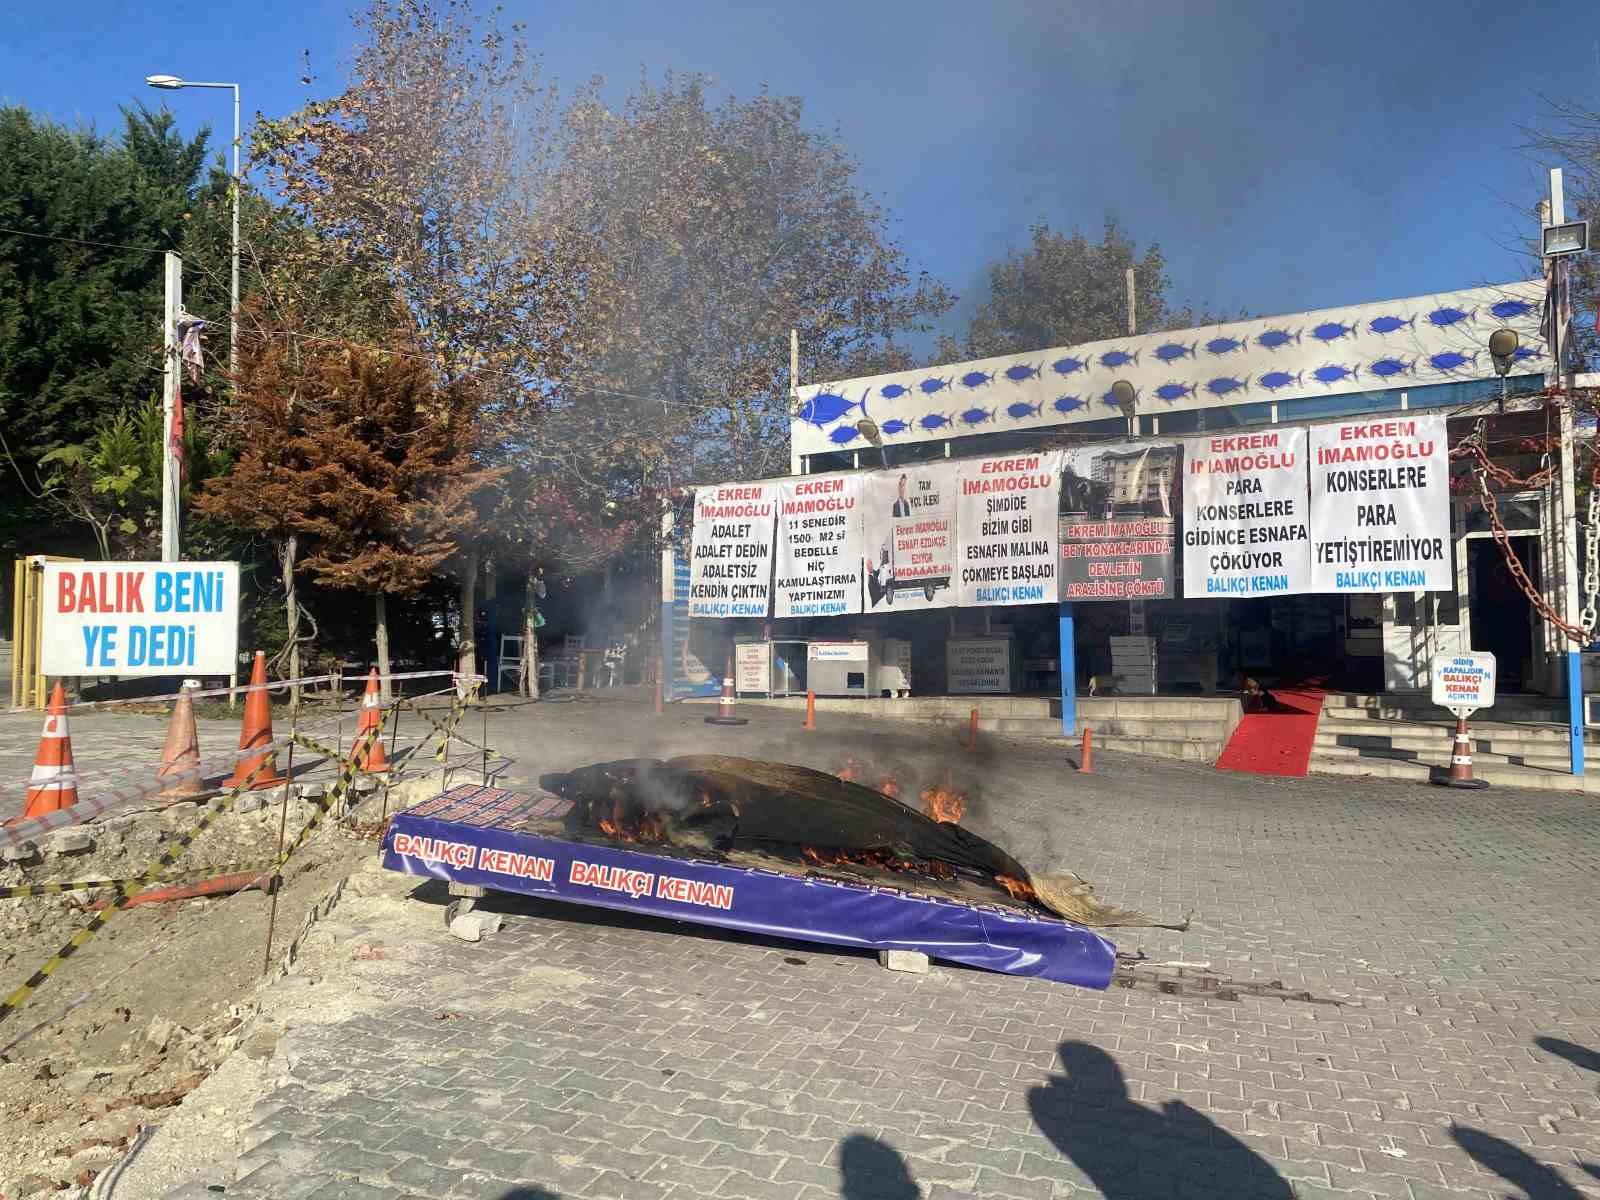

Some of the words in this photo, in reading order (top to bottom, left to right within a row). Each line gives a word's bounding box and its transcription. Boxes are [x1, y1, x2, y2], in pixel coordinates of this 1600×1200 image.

[1340, 422, 1416, 440] EKREM
[1211, 434, 1278, 453] EKREM
[1317, 441, 1434, 465] İMAMOĞLU
[981, 458, 1040, 474] EKREM
[1190, 452, 1295, 474] İMAMOĞLU
[795, 480, 844, 496] EKREM
[962, 474, 1052, 496] İMAMOĞLU
[1226, 478, 1263, 496] PARA
[1326, 466, 1427, 493] KONSERLERE
[717, 488, 762, 501] EKREM
[986, 494, 1027, 516] ŞİMDİDE
[1197, 500, 1294, 522] KONSERLERE
[788, 520, 799, 530] 11
[802, 514, 846, 529] SENEDİR
[1357, 504, 1396, 527] PARA
[711, 524, 752, 538] ADALET
[982, 518, 1008, 537] BİZİM
[1012, 516, 1032, 534] GİBİ
[1068, 524, 1104, 538] EKREM
[1185, 526, 1246, 547] GİDİNCE
[1249, 524, 1308, 544] ESNAFA
[820, 531, 834, 542] M2
[695, 544, 732, 558] ADALET
[736, 540, 768, 558] DEDİN
[794, 546, 838, 558] BEDELLE
[967, 544, 1008, 560] ESNAFIN
[1010, 541, 1049, 557] MALINA
[1316, 534, 1444, 568] YETİŞTİREMİYOR
[702, 562, 758, 579] ADALETSİZ
[807, 560, 825, 574] HİÇ
[1210, 550, 1283, 574] ÇÖKÜYOR
[778, 574, 857, 589] KAMULAŞTIRMA
[1012, 564, 1054, 583] BAŞLADI
[1336, 571, 1382, 592] BALIKÇI
[1385, 570, 1426, 588] KENAN
[58, 571, 145, 614] BALIK
[690, 582, 728, 598] KENDİN
[731, 584, 768, 602] ÇIKTIN
[1126, 578, 1165, 598] ÇÖKTÜ
[1207, 576, 1249, 594] BALIKÇI
[1252, 575, 1288, 591] KENAN
[788, 590, 846, 602] YAPTINIZMI
[976, 588, 1010, 604] BALIKÇI
[1012, 588, 1043, 600] KENAN
[693, 604, 729, 617] BALIKÇI
[731, 603, 765, 614] KENAN
[790, 603, 818, 616] BALIKÇI
[820, 602, 848, 614] KENAN
[82, 625, 118, 667] YE
[1443, 674, 1482, 685] BALIKÇI
[1446, 684, 1480, 693] KENAN
[394, 833, 476, 870] BALIKÇI
[479, 848, 555, 882] KENAN
[570, 861, 655, 898] BALIKÇI
[656, 875, 734, 910] KENAN
